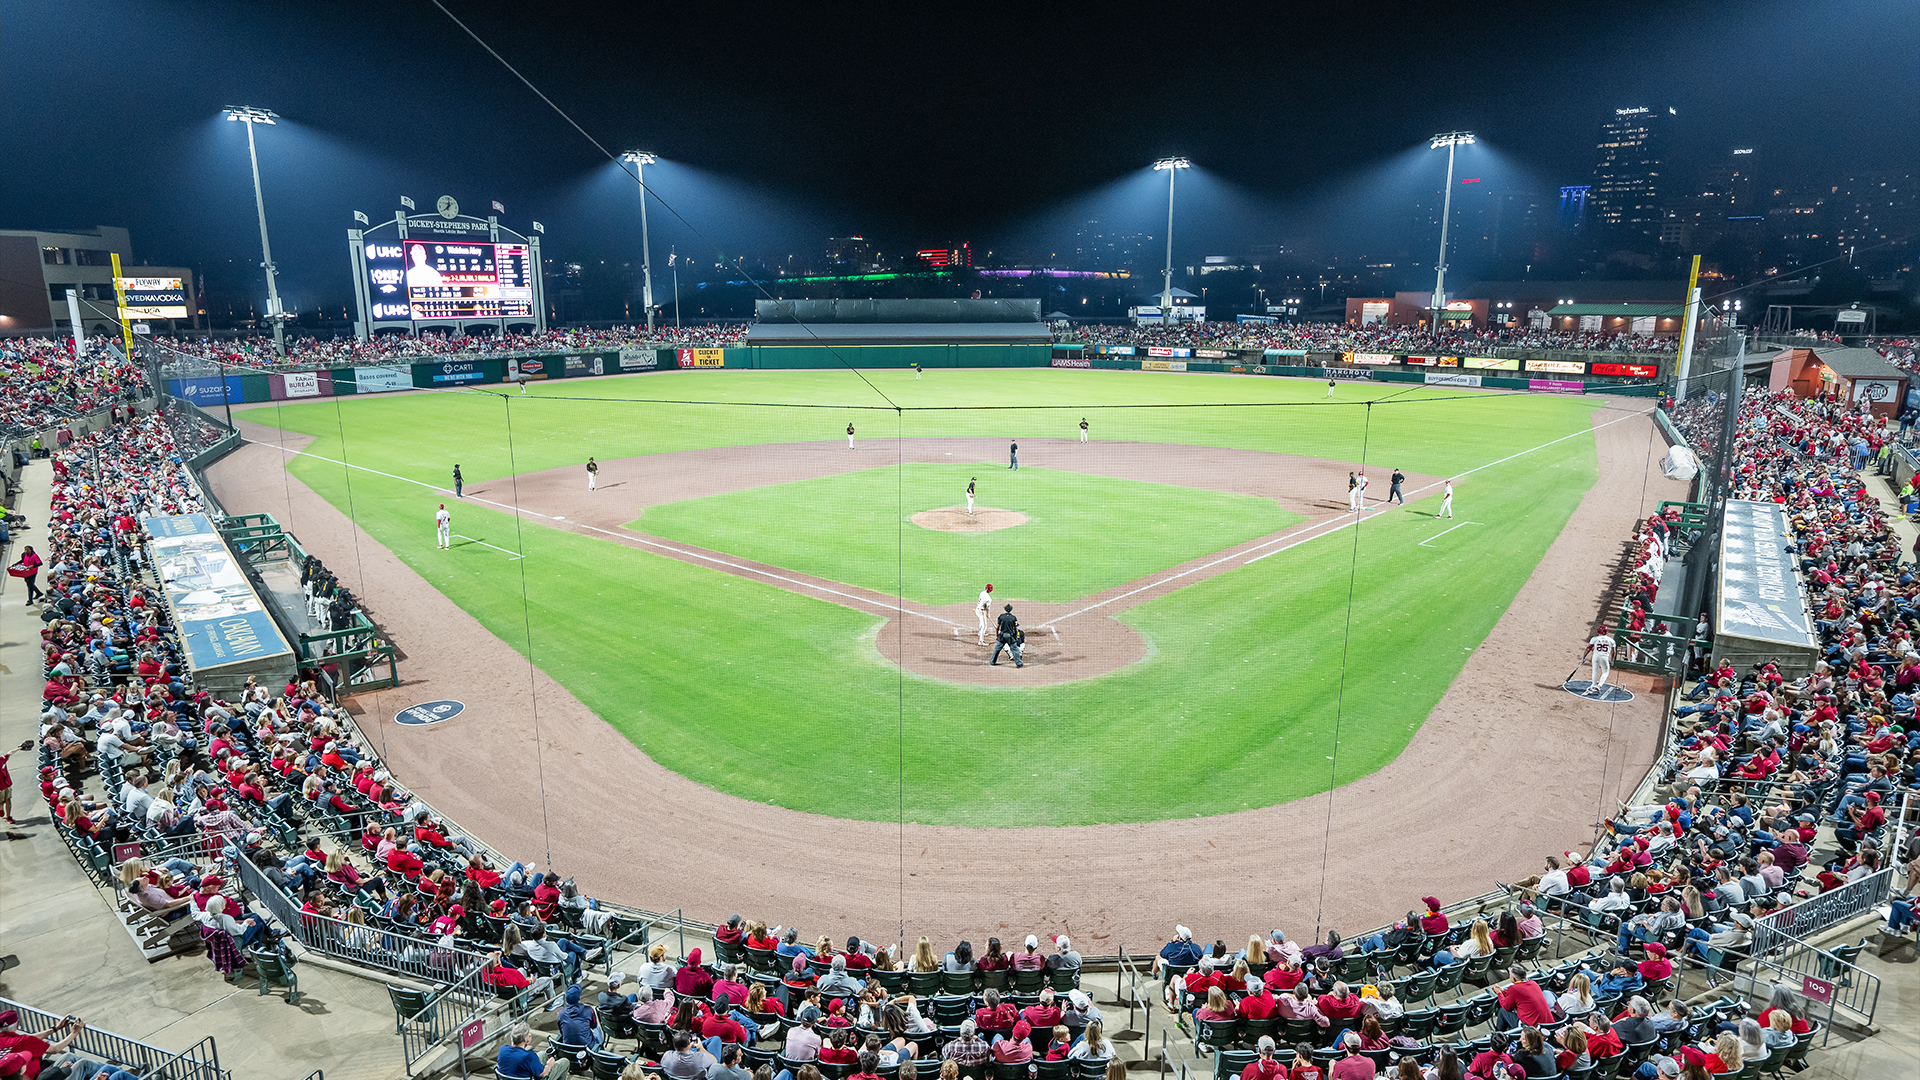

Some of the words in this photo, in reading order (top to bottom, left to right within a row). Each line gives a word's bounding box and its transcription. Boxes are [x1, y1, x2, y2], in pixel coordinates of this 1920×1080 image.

[408, 220, 470, 230] DICKEY-STEPHENS
[377, 247, 402, 257] UHC
[384, 305, 409, 315] UHC
[218, 618, 264, 656] OAKLAWN
[1597, 644, 1608, 652] 25
[1809, 981, 1825, 994] 109
[468, 1025, 478, 1036] 110
